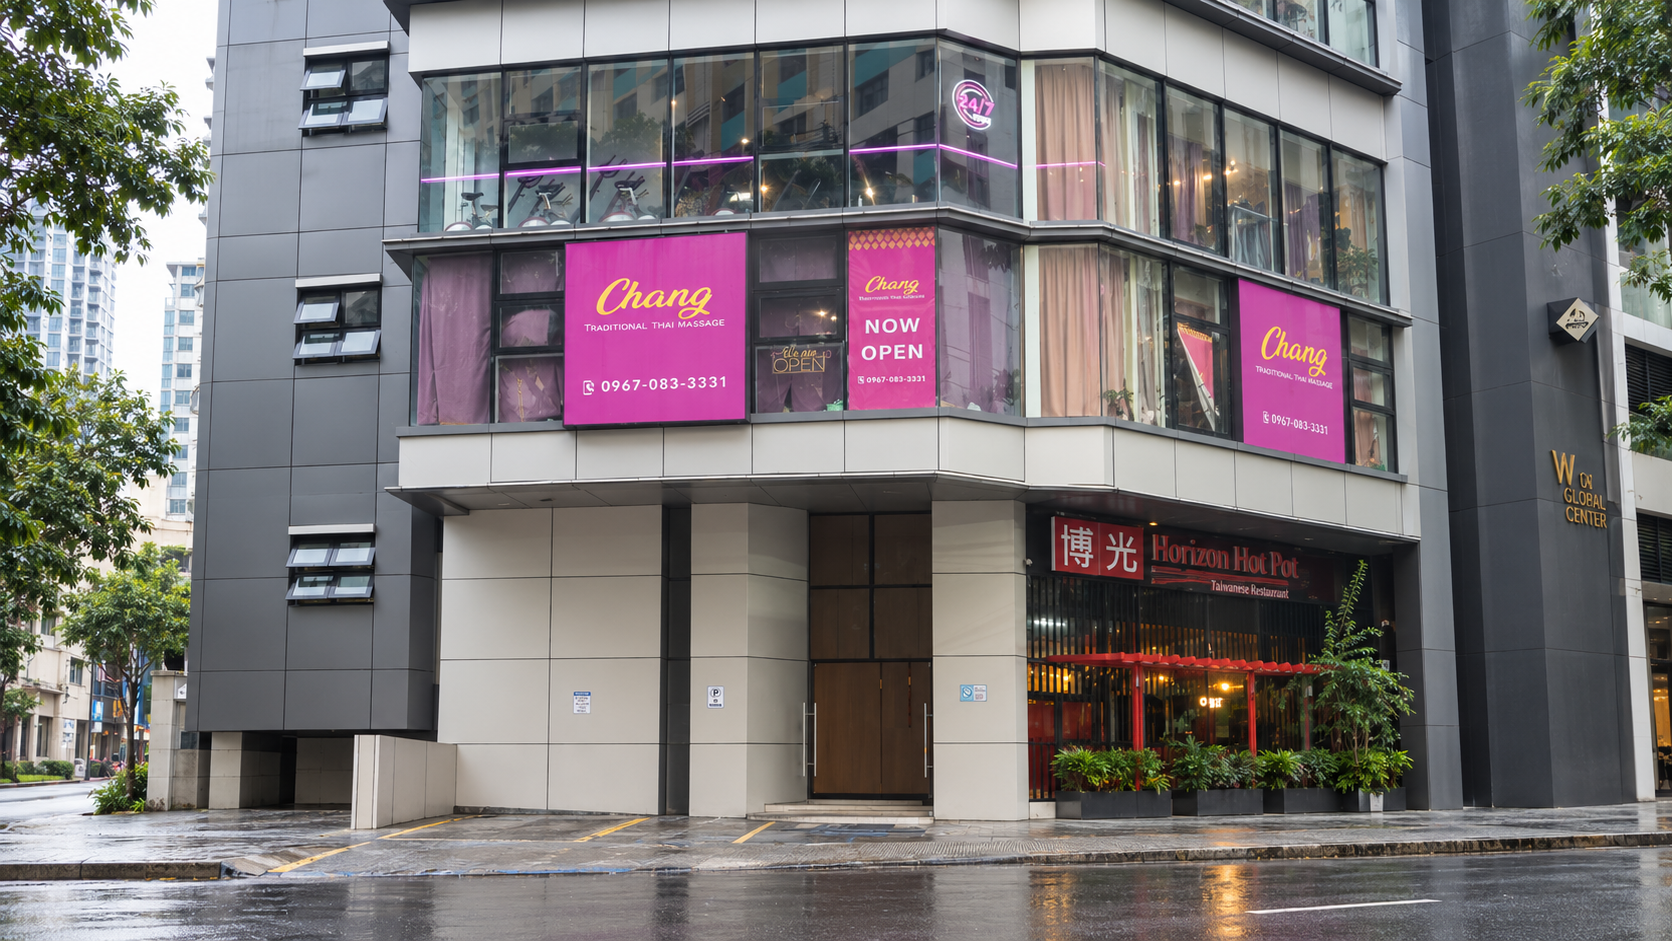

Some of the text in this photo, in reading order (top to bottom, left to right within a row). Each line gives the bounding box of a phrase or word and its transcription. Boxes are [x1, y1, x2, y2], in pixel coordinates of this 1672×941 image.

[958, 93, 995, 117] 24/7
[865, 275, 919, 295] Chang
[596, 277, 713, 320] Chang
[584, 318, 725, 332] TRADITIONAL THAI MASSAGE
[865, 317, 920, 334] NOW
[861, 344, 923, 361] OPEN
[1261, 326, 1328, 377] Chang
[773, 357, 826, 373] OPEN
[601, 375, 726, 392] 0967-083-3331
[1271, 413, 1329, 435] 0967-083-3331
[1551, 449, 1576, 486] W
[1563, 487, 1607, 511] GLOBAL
[1565, 505, 1608, 529] CENTER
[1151, 533, 1300, 579] Horizon Hot Pot
